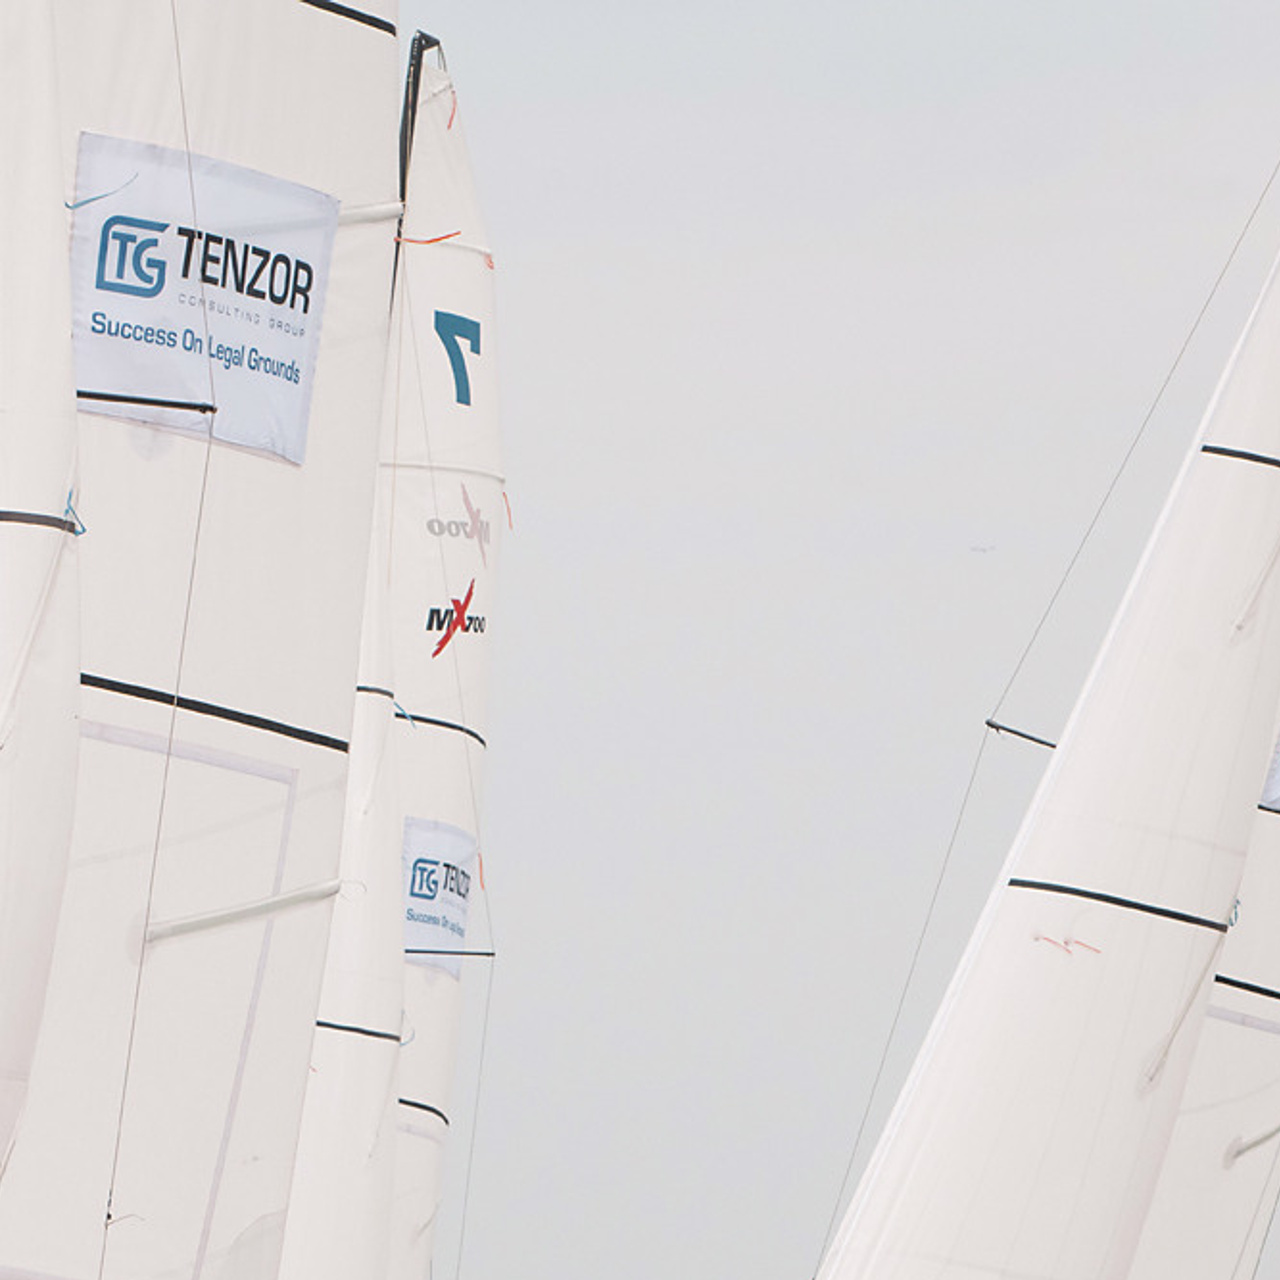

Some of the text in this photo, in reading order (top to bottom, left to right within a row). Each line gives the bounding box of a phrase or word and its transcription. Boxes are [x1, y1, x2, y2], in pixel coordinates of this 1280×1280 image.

[177, 226, 313, 314] TENZOR
[90, 311, 301, 385] Success On Legal Grounds
[178, 293, 306, 338] CONSULTING GROUP
